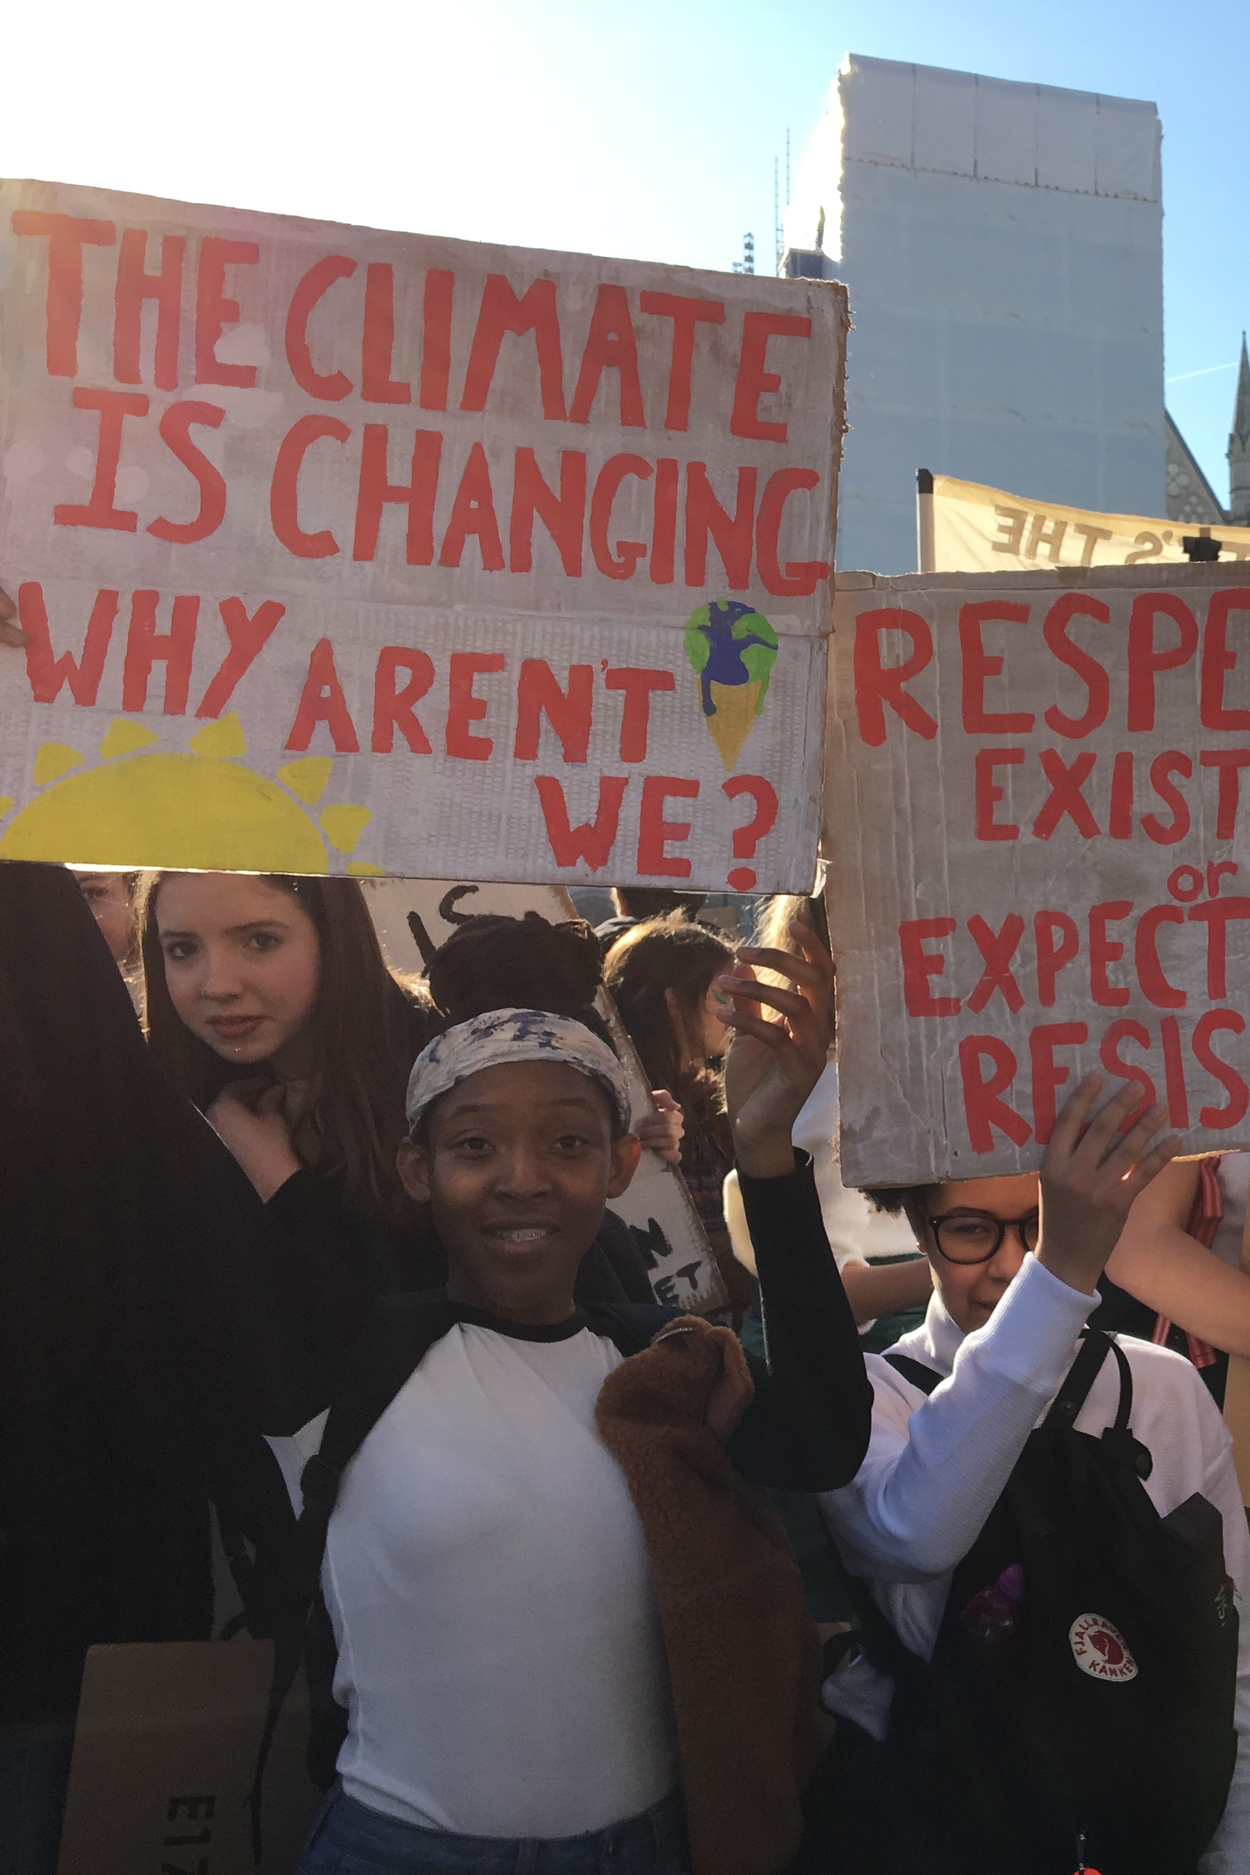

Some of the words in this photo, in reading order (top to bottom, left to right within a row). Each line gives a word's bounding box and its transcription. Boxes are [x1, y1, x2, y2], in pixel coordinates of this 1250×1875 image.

[12, 210, 260, 390] THE
[285, 254, 812, 442] CLIMATE
[53, 387, 227, 544] IS
[270, 413, 829, 596] CHANGING
[18, 581, 286, 718] WHY
[285, 638, 675, 763] AREN'T
[534, 774, 779, 891] WE?
[1166, 861, 1239, 902] or
